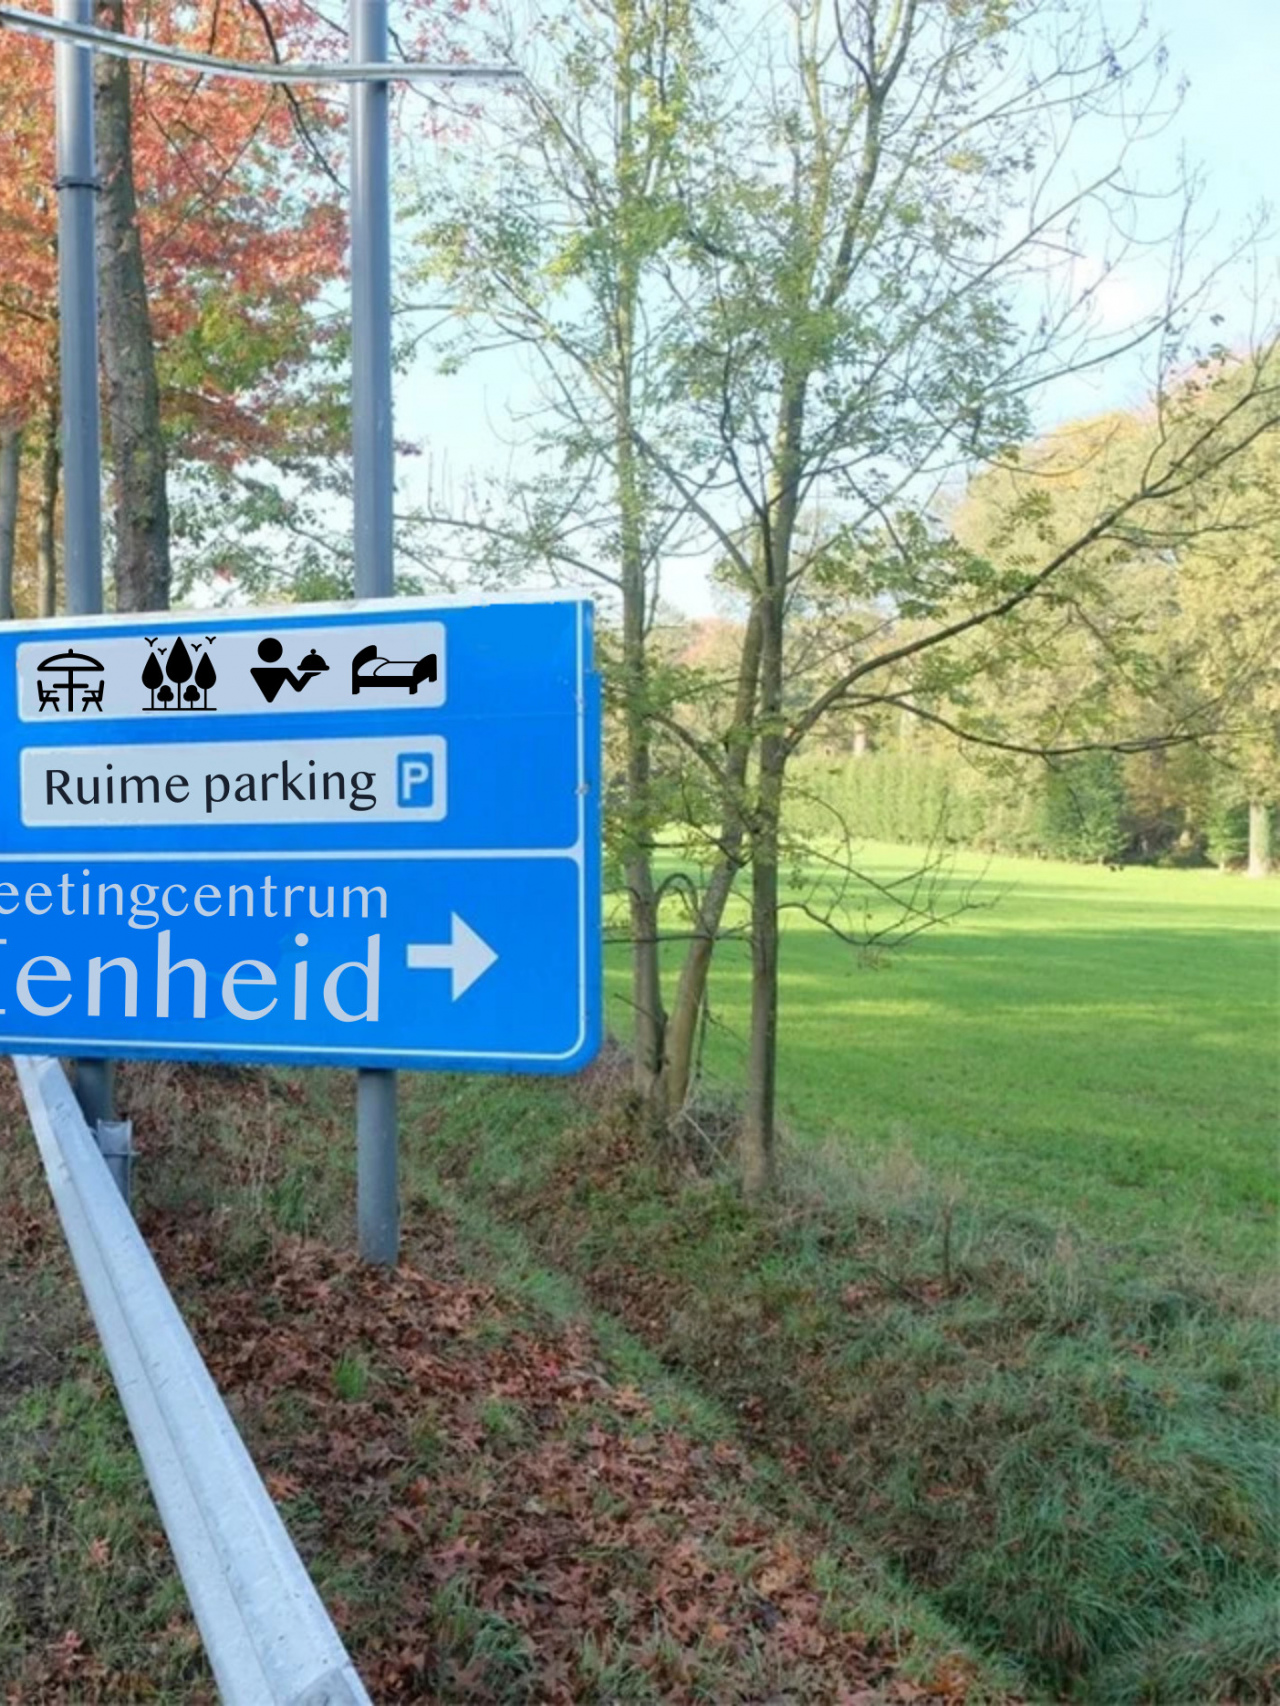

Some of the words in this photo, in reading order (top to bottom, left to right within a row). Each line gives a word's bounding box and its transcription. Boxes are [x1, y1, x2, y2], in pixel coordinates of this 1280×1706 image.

[45, 763, 190, 806] Ruime
[204, 759, 377, 813] parking
[402, 761, 429, 799] P
